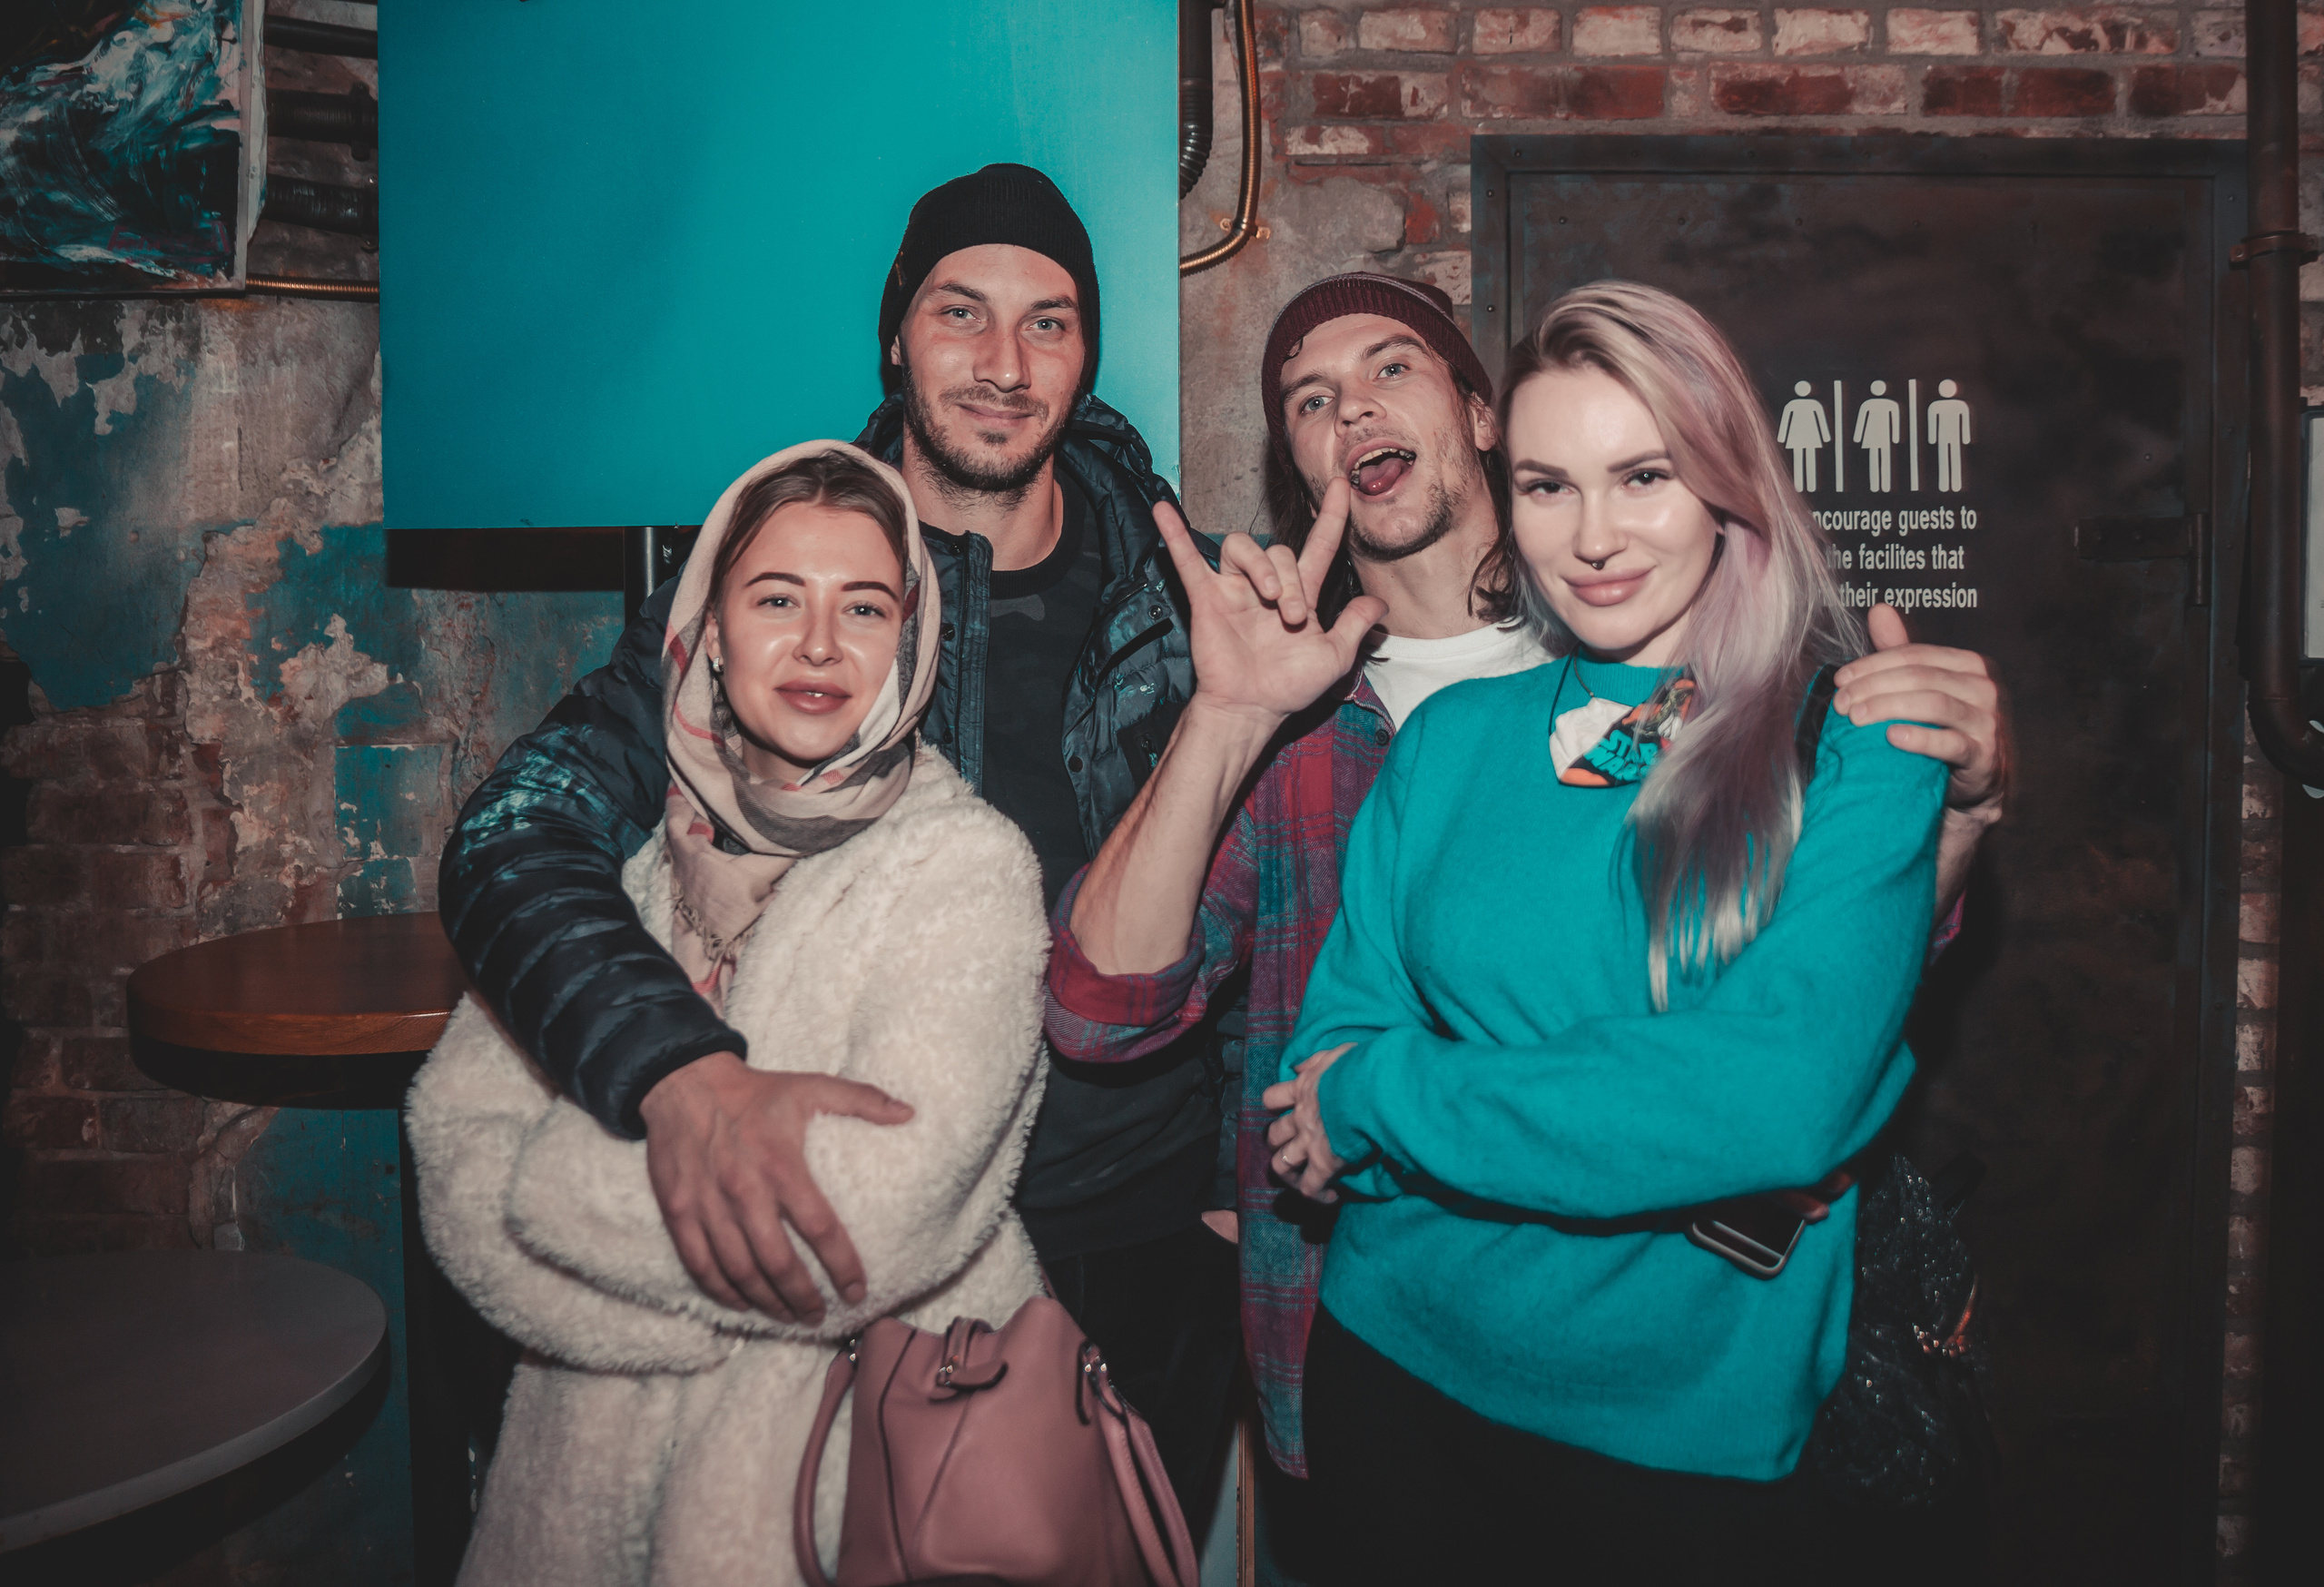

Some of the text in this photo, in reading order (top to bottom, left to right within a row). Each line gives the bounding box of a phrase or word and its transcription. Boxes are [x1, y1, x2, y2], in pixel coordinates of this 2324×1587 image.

[1811, 506, 1977, 537] ncourage guests to
[1826, 543, 1965, 570] the facilites that
[1839, 581, 1878, 607] their
[1884, 582, 1978, 614] expression
